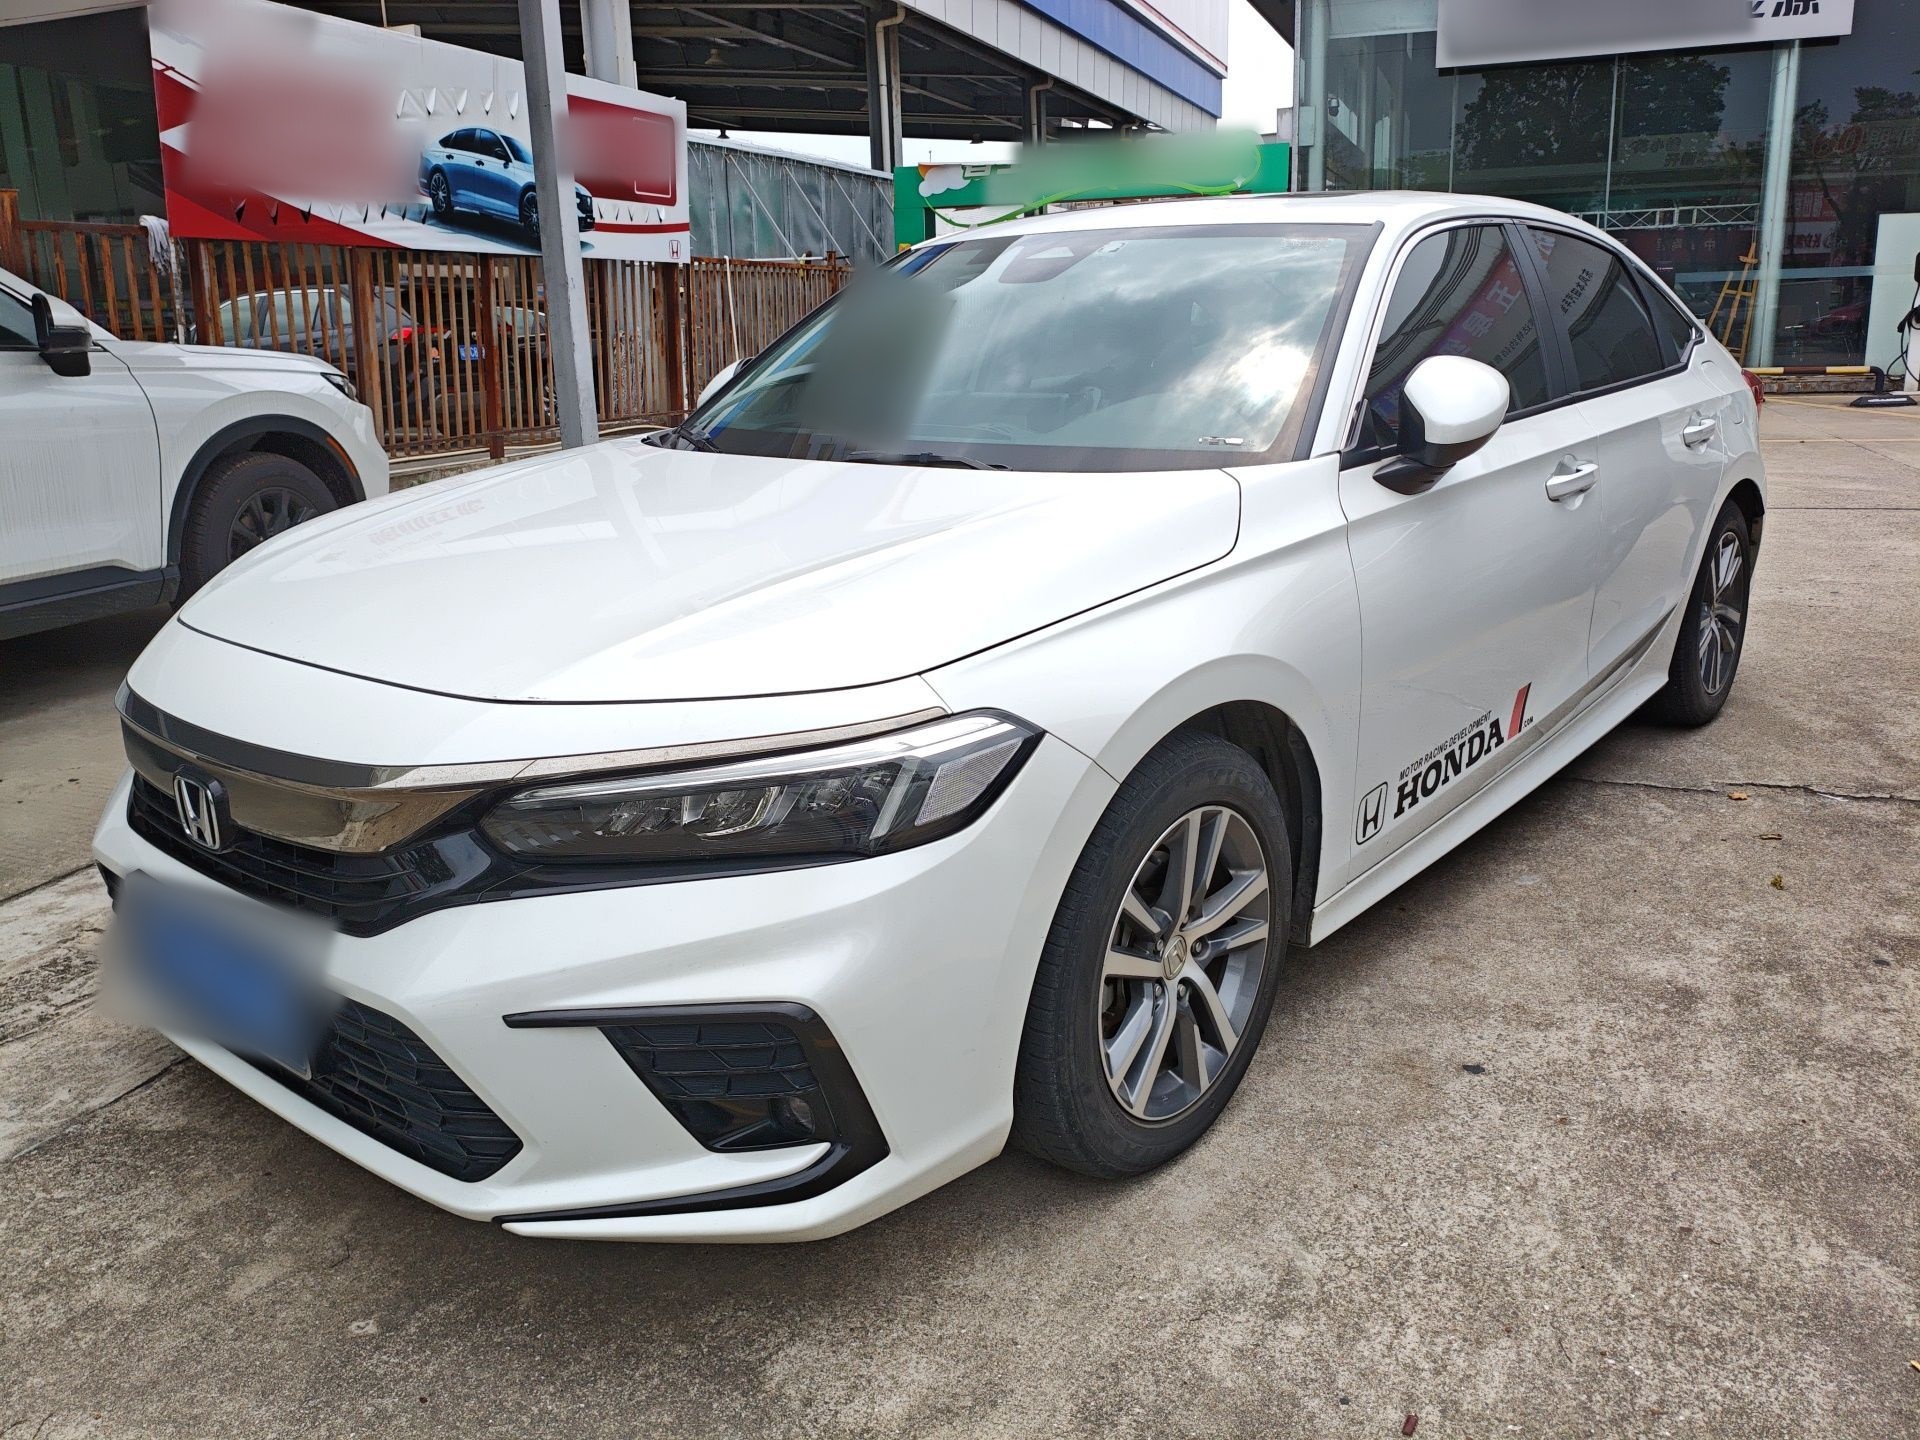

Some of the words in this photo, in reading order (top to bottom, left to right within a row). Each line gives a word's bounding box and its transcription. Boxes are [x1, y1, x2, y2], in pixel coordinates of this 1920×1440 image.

[1393, 717, 1504, 819] HONDA
[1399, 757, 1424, 781] MOTOR
[1424, 740, 1449, 765] RACING
[1449, 710, 1493, 748] DEVELOPMENT
